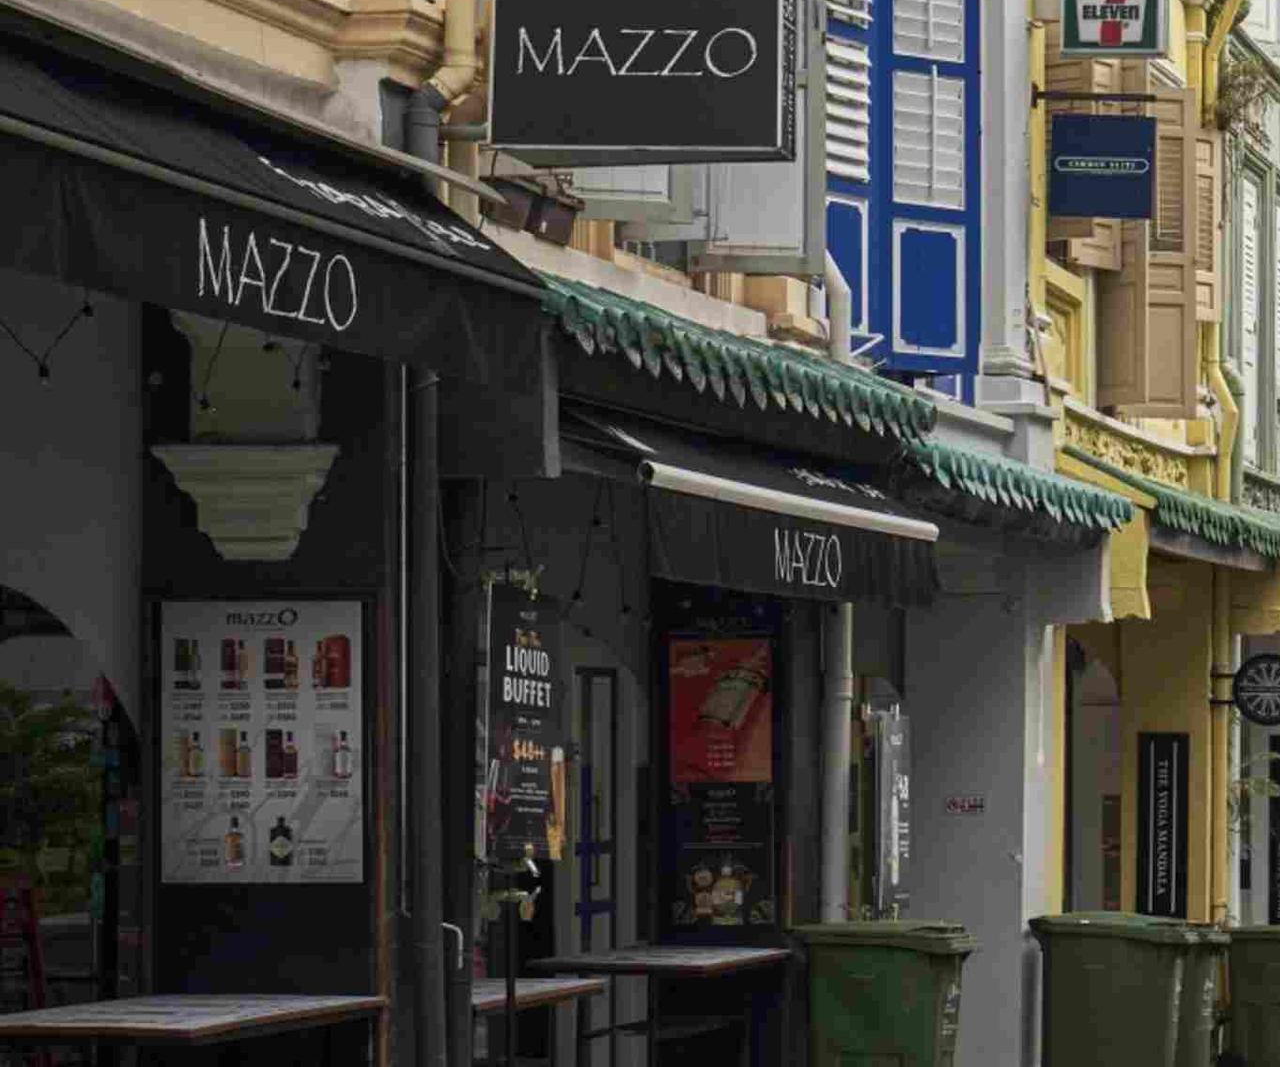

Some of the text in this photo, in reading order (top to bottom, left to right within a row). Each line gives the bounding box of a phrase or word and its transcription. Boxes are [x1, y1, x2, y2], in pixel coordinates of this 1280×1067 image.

[517, 27, 758, 79] MAZZO
[198, 217, 358, 331] MAZZO
[774, 527, 842, 588] MAZZO
[505, 644, 550, 677] LIQUID
[503, 676, 552, 708] BUFFET
[1156, 759, 1169, 895] THE YOGA MANDALA
